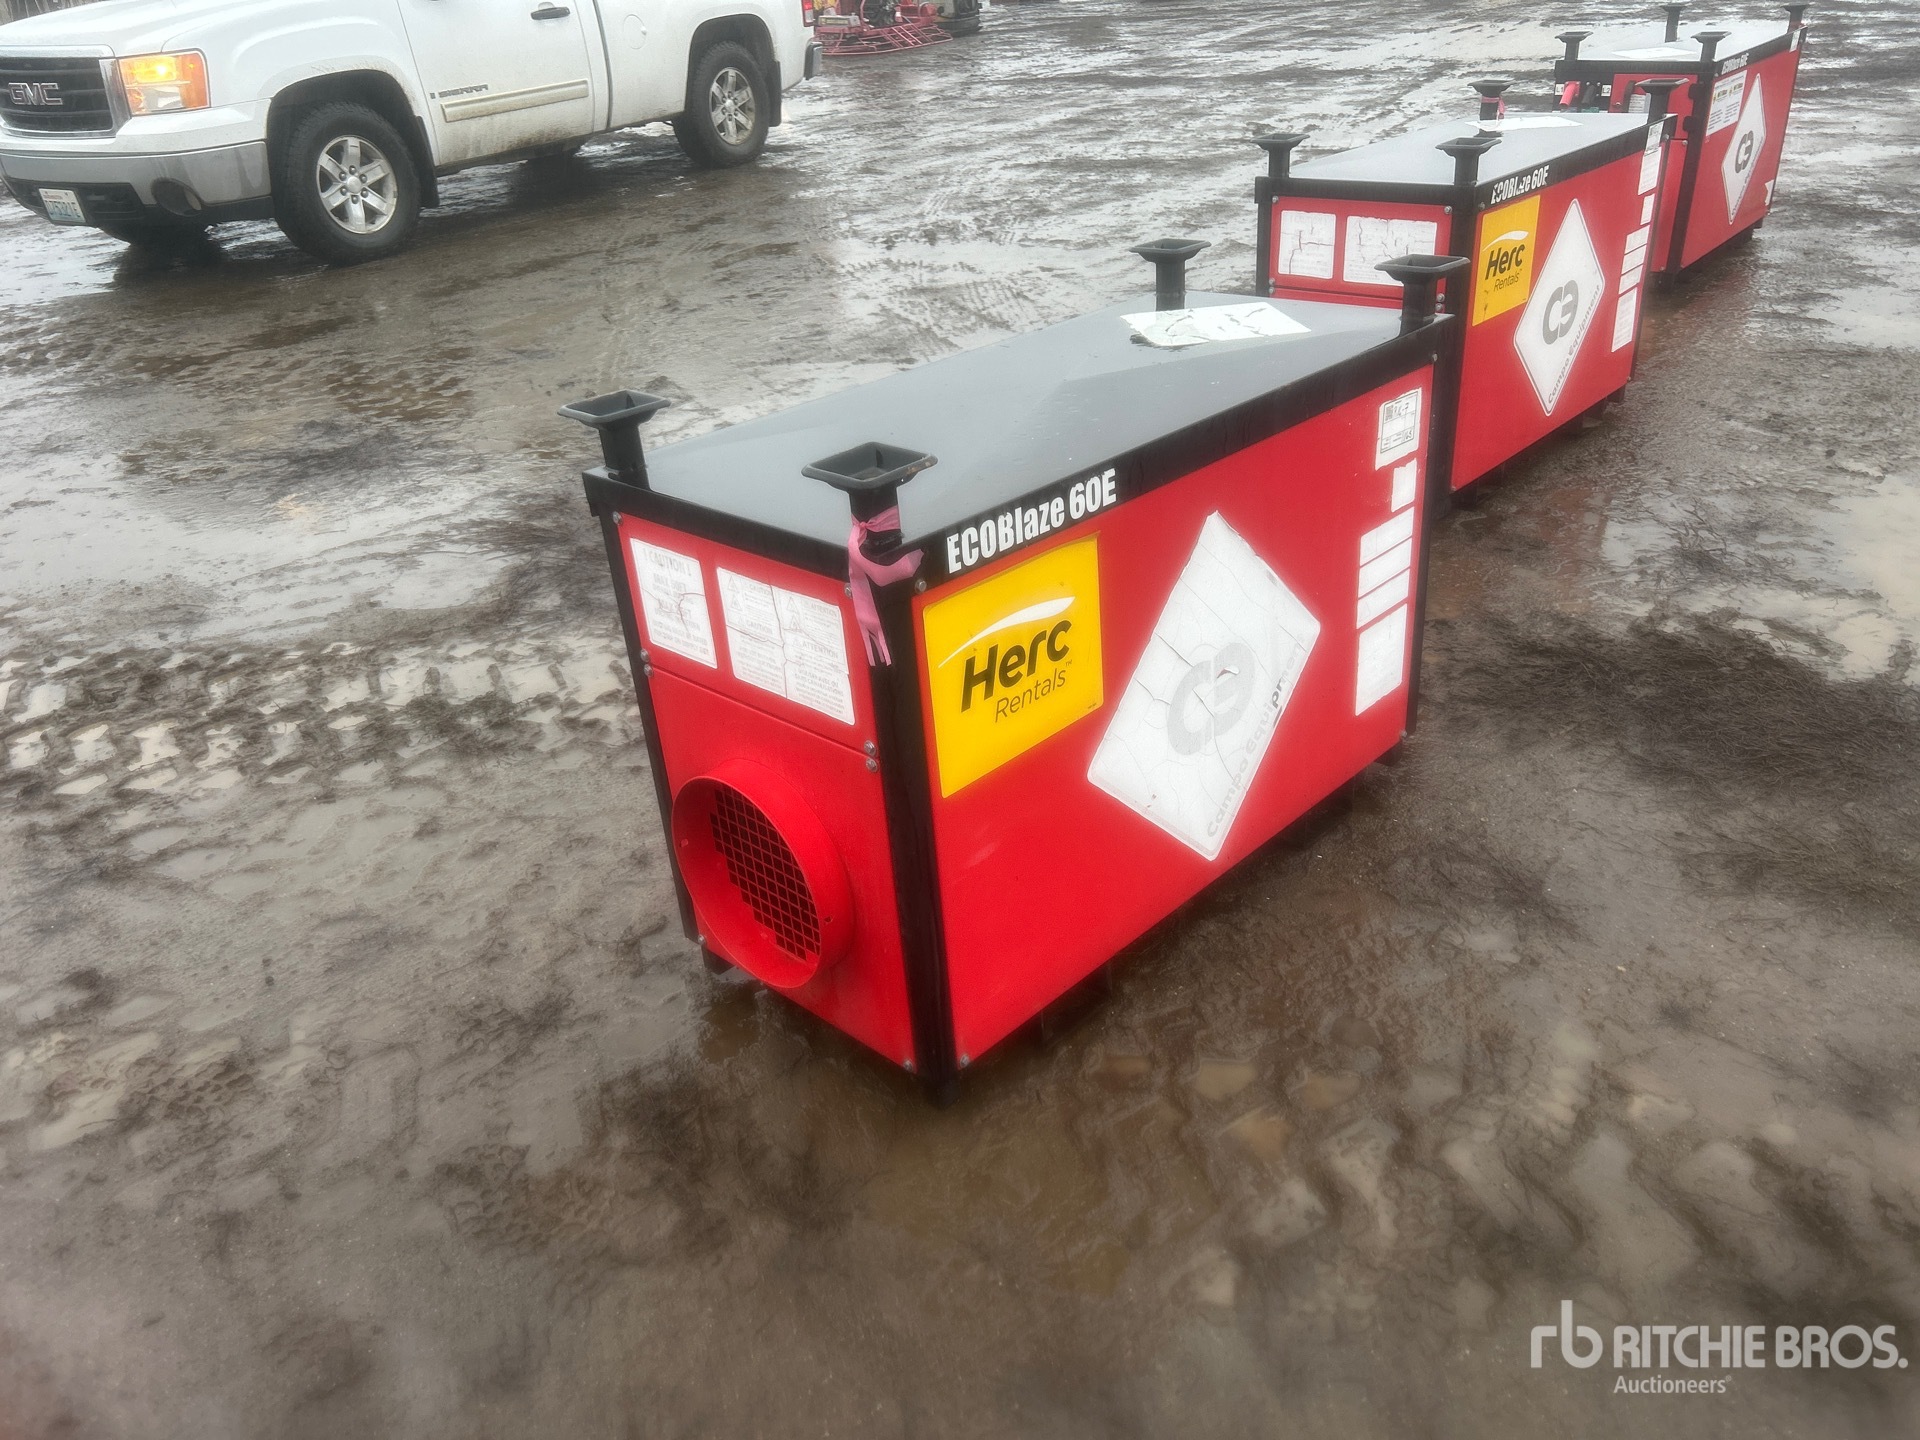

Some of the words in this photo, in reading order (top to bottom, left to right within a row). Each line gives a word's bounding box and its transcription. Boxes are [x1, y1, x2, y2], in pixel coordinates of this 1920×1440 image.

[8, 82, 63, 106] GMC
[1484, 244, 1526, 281] Herc
[1493, 270, 1520, 293] Rentals
[1548, 357, 1570, 404] Campo
[1568, 284, 1601, 356] Equipment
[947, 497, 1065, 574] ECOBlaze
[1069, 468, 1117, 520] 60E
[961, 620, 1072, 712] Herc
[994, 669, 1066, 723] Rentals
